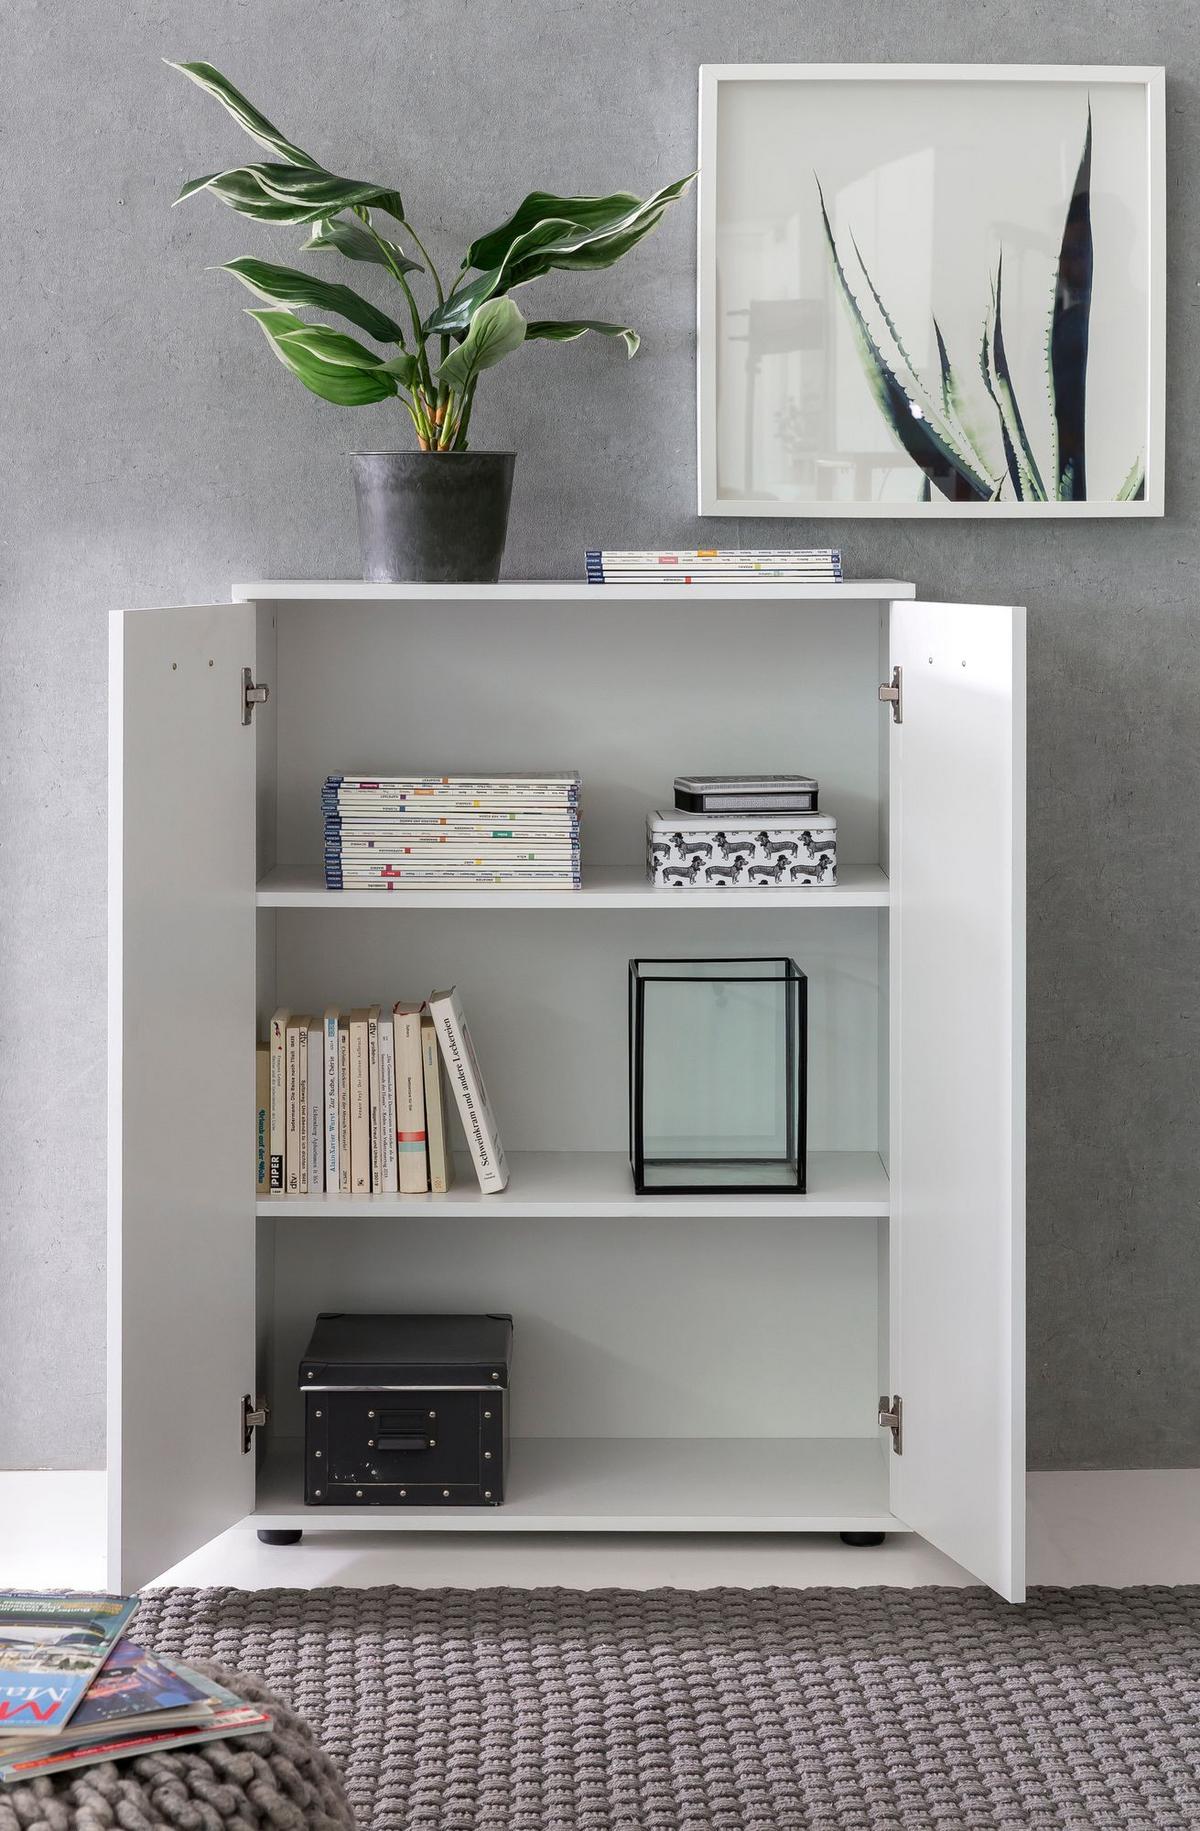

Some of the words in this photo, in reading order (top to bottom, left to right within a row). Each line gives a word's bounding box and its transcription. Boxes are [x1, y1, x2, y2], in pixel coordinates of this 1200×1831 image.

[369, 1022, 377, 1036] dtv
[443, 1017, 461, 1062] Leckereien
[456, 1063, 469, 1091] andere
[462, 1093, 474, 1109] und
[470, 1111, 490, 1167] Schweinkram
[271, 1156, 280, 1185] PIPER
[289, 1175, 297, 1190] dtv
